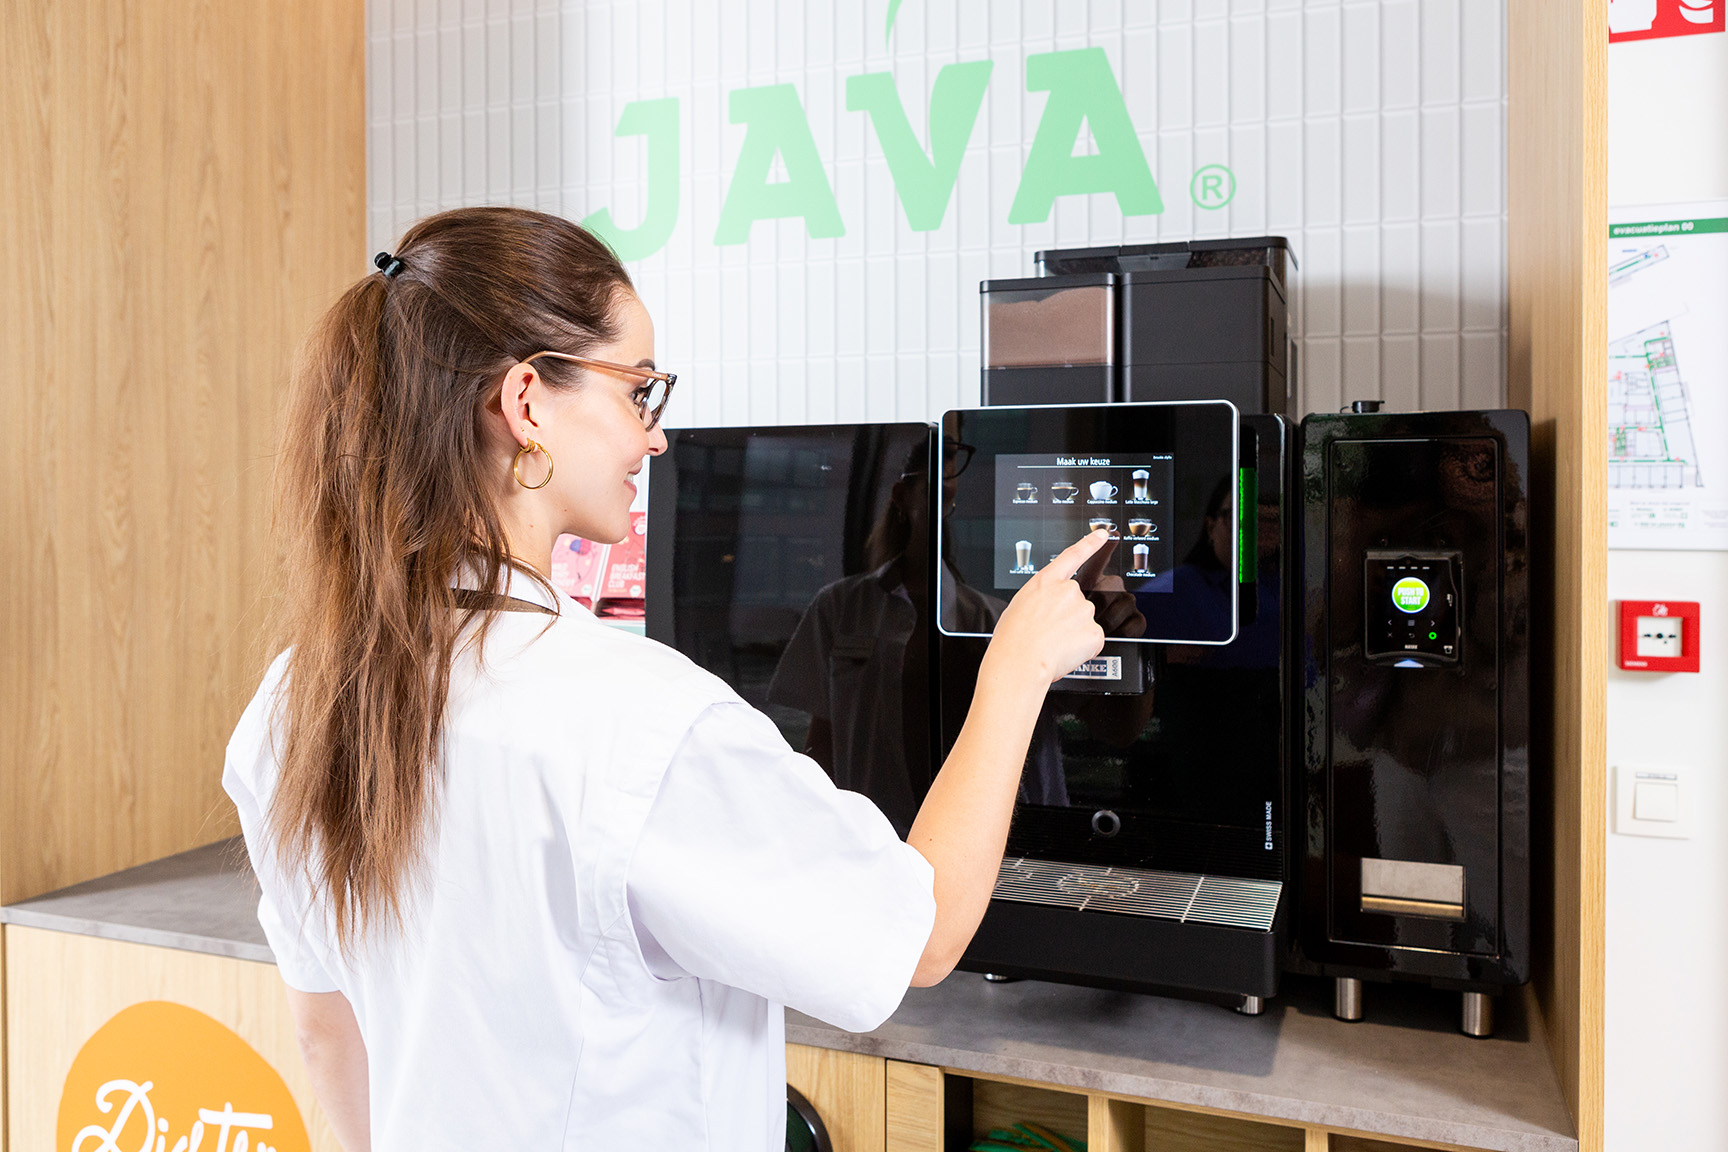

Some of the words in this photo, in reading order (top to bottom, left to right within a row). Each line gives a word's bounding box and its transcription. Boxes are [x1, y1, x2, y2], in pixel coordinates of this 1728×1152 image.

[581, 47, 1164, 262] JAVA
[1613, 223, 1680, 235] evacuatieplan
[1056, 456, 1077, 466] Maak
[1077, 458, 1089, 466] uw
[1089, 456, 1111, 466] keuze
[1397, 587, 1415, 596] PUSH
[1415, 587, 1424, 596] TO
[1400, 597, 1421, 605] START
[1074, 664, 1107, 672] ANKE
